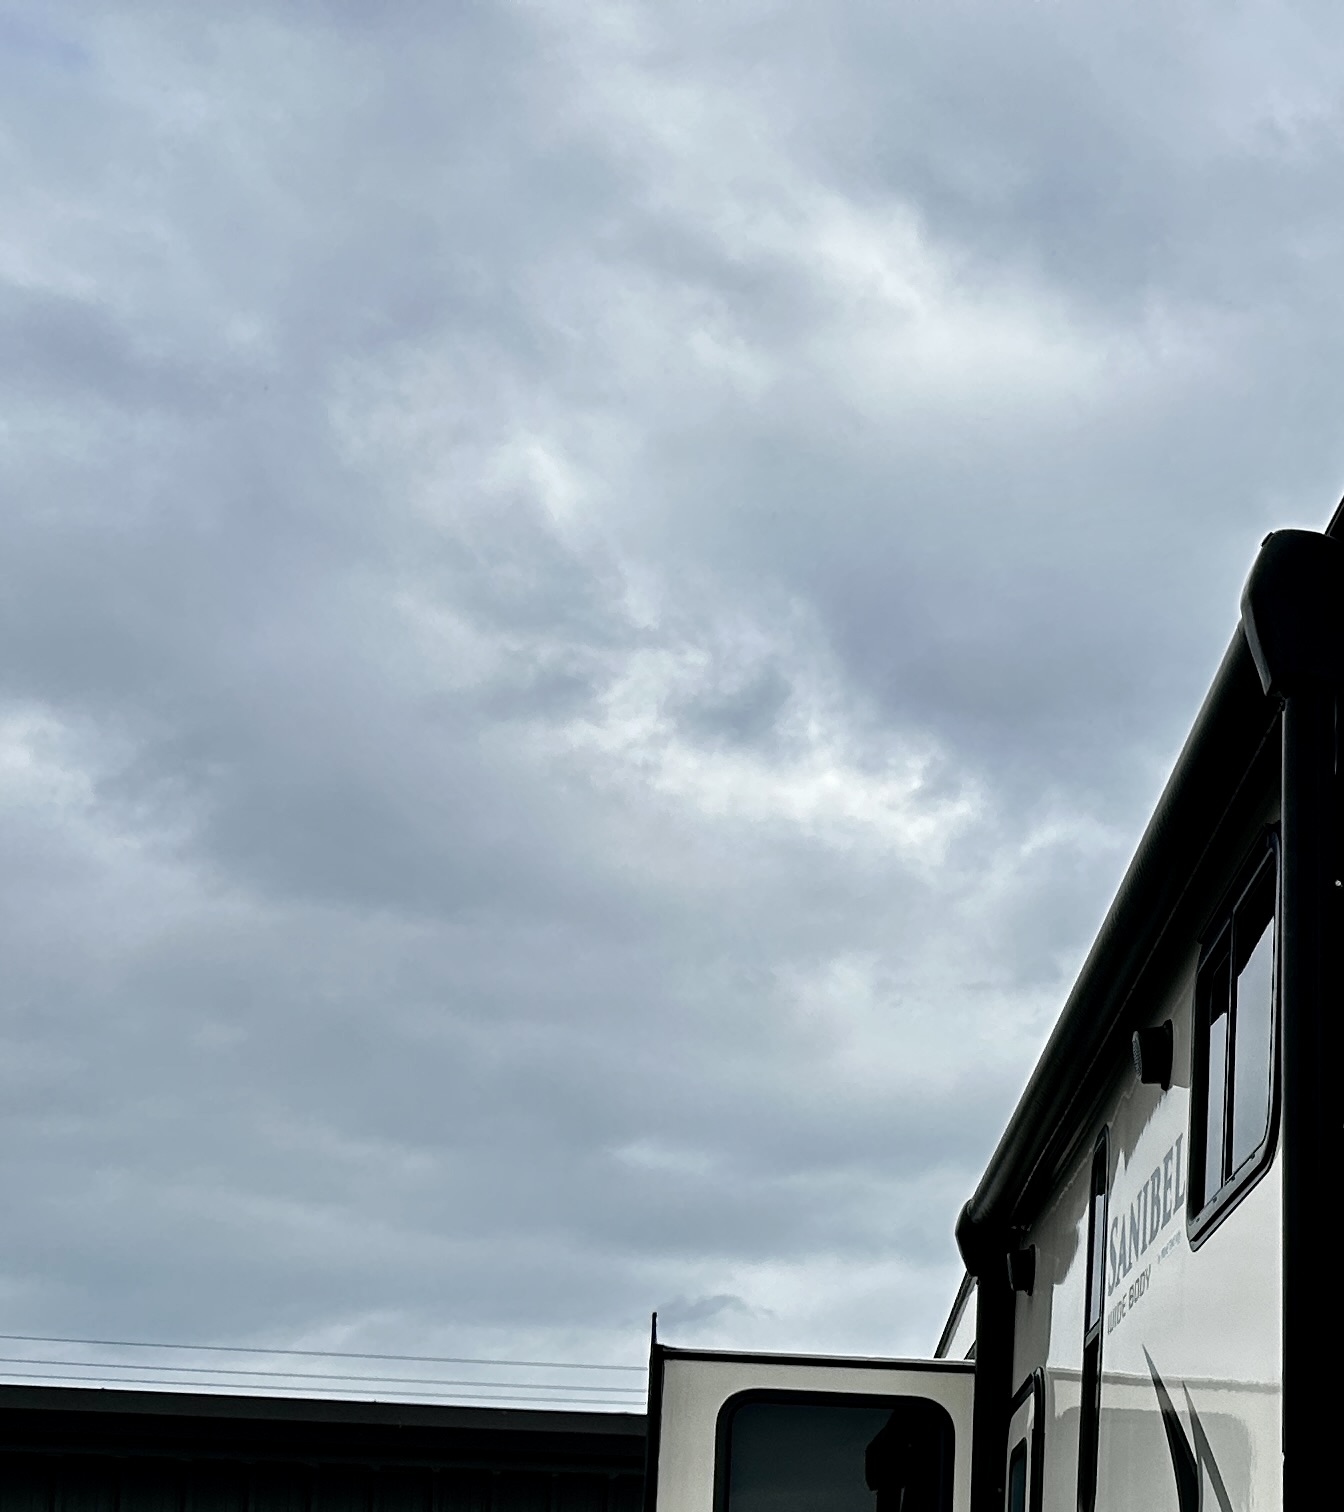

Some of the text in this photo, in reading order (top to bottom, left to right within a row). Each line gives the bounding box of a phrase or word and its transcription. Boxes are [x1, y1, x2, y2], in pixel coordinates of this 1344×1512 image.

[1107, 1133, 1186, 1297] SANIBEL
[1107, 1263, 1152, 1335] WIDE BODY
